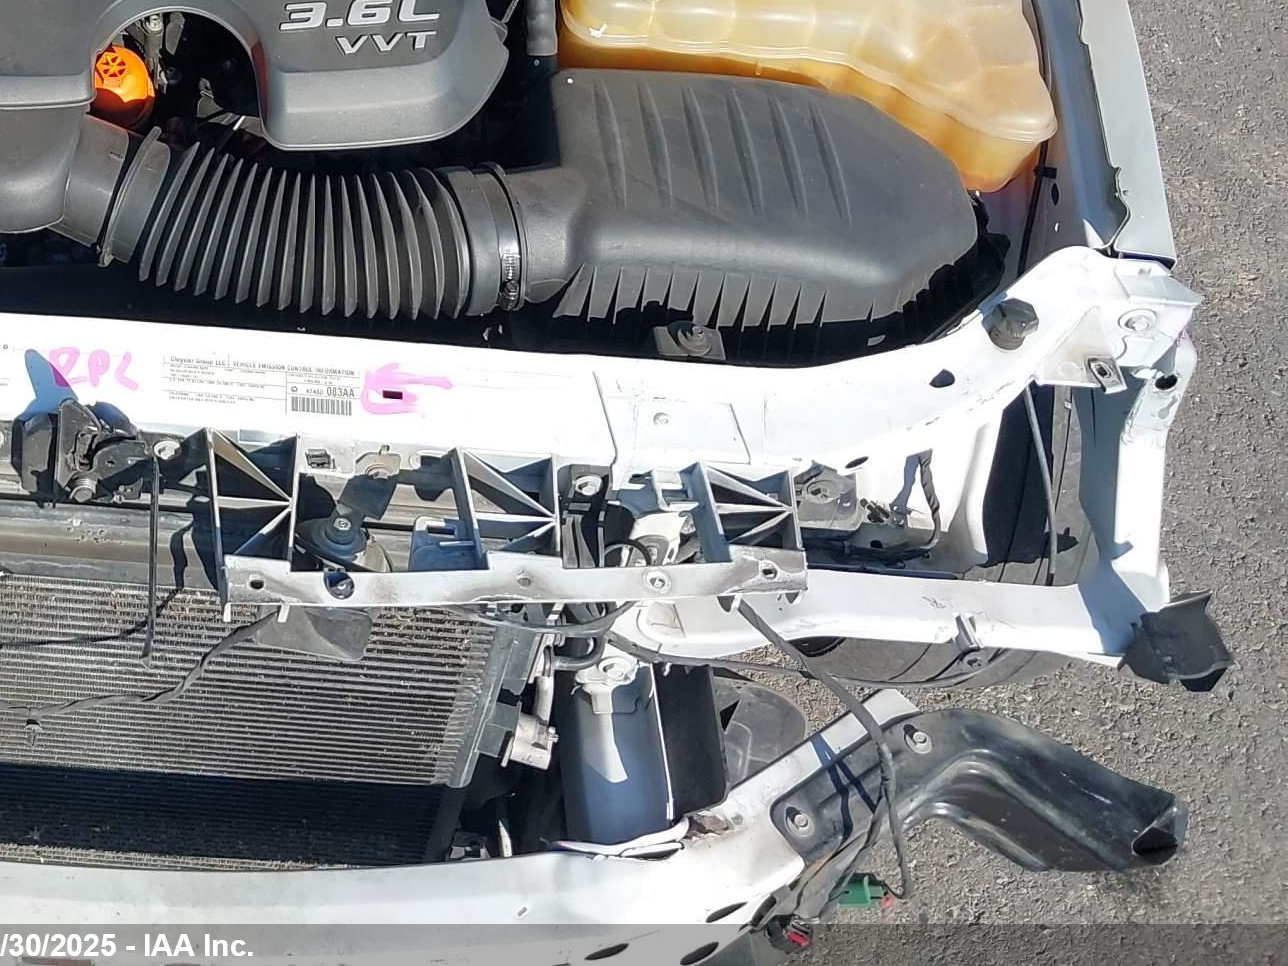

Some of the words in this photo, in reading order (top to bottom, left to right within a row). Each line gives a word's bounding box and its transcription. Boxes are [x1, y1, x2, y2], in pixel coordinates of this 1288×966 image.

[335, 30, 437, 55] VVT
[170, 355, 194, 364] Chrysler
[195, 358, 214, 367] Group
[233, 361, 256, 369] VEHICLE
[258, 362, 286, 371] EMISSION
[287, 365, 313, 373] CONTROL
[314, 366, 355, 376] INFORMATION
[326, 386, 355, 398] 083AA
